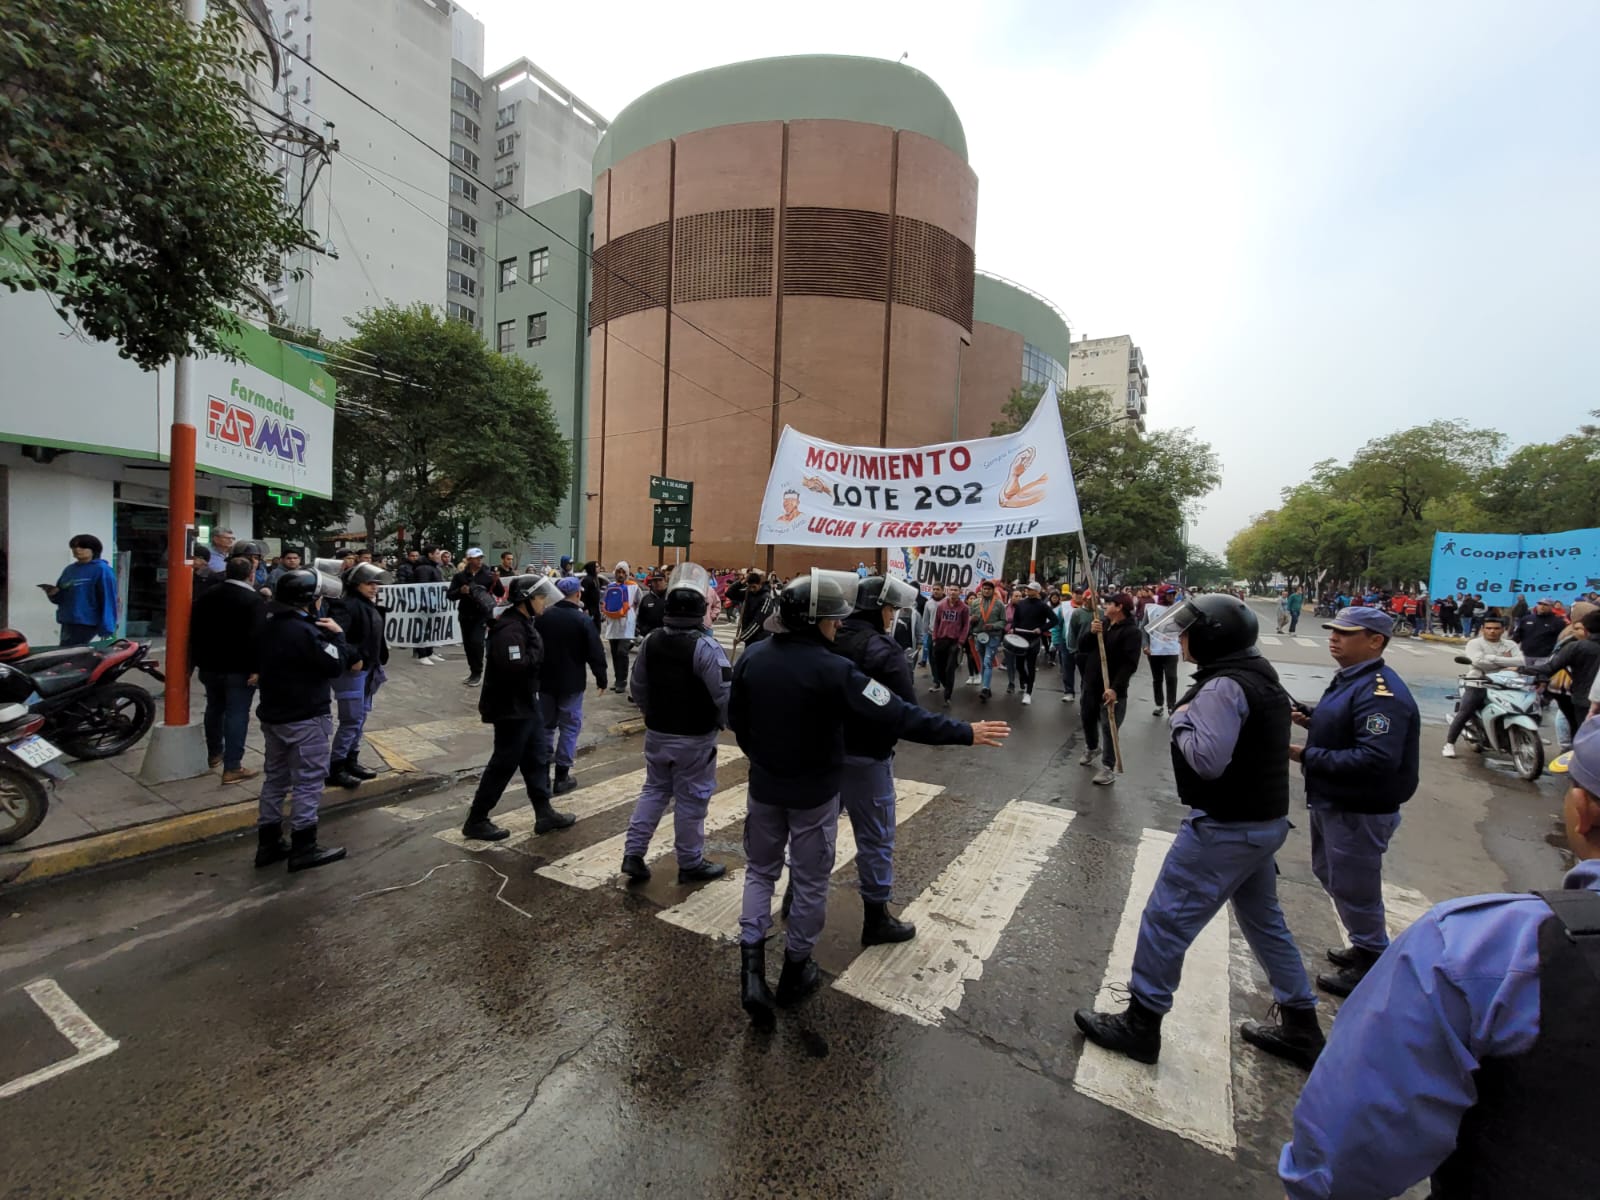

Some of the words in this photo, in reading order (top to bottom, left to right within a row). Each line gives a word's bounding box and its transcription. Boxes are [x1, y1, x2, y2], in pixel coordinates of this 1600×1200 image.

[230, 378, 295, 420] Farmacias
[805, 446, 971, 480] MOVIMIENTO
[832, 484, 900, 511] LOTE
[914, 482, 983, 511] 202
[807, 516, 857, 538] LUCHA
[860, 522, 873, 539] Y
[1460, 546, 1582, 561] Cooperativa
[917, 559, 973, 587] UNIDO
[1456, 577, 1467, 590] 8
[1475, 579, 1503, 593] de
[1508, 579, 1578, 593] Enero
[386, 616, 453, 643] OLIDARIA
